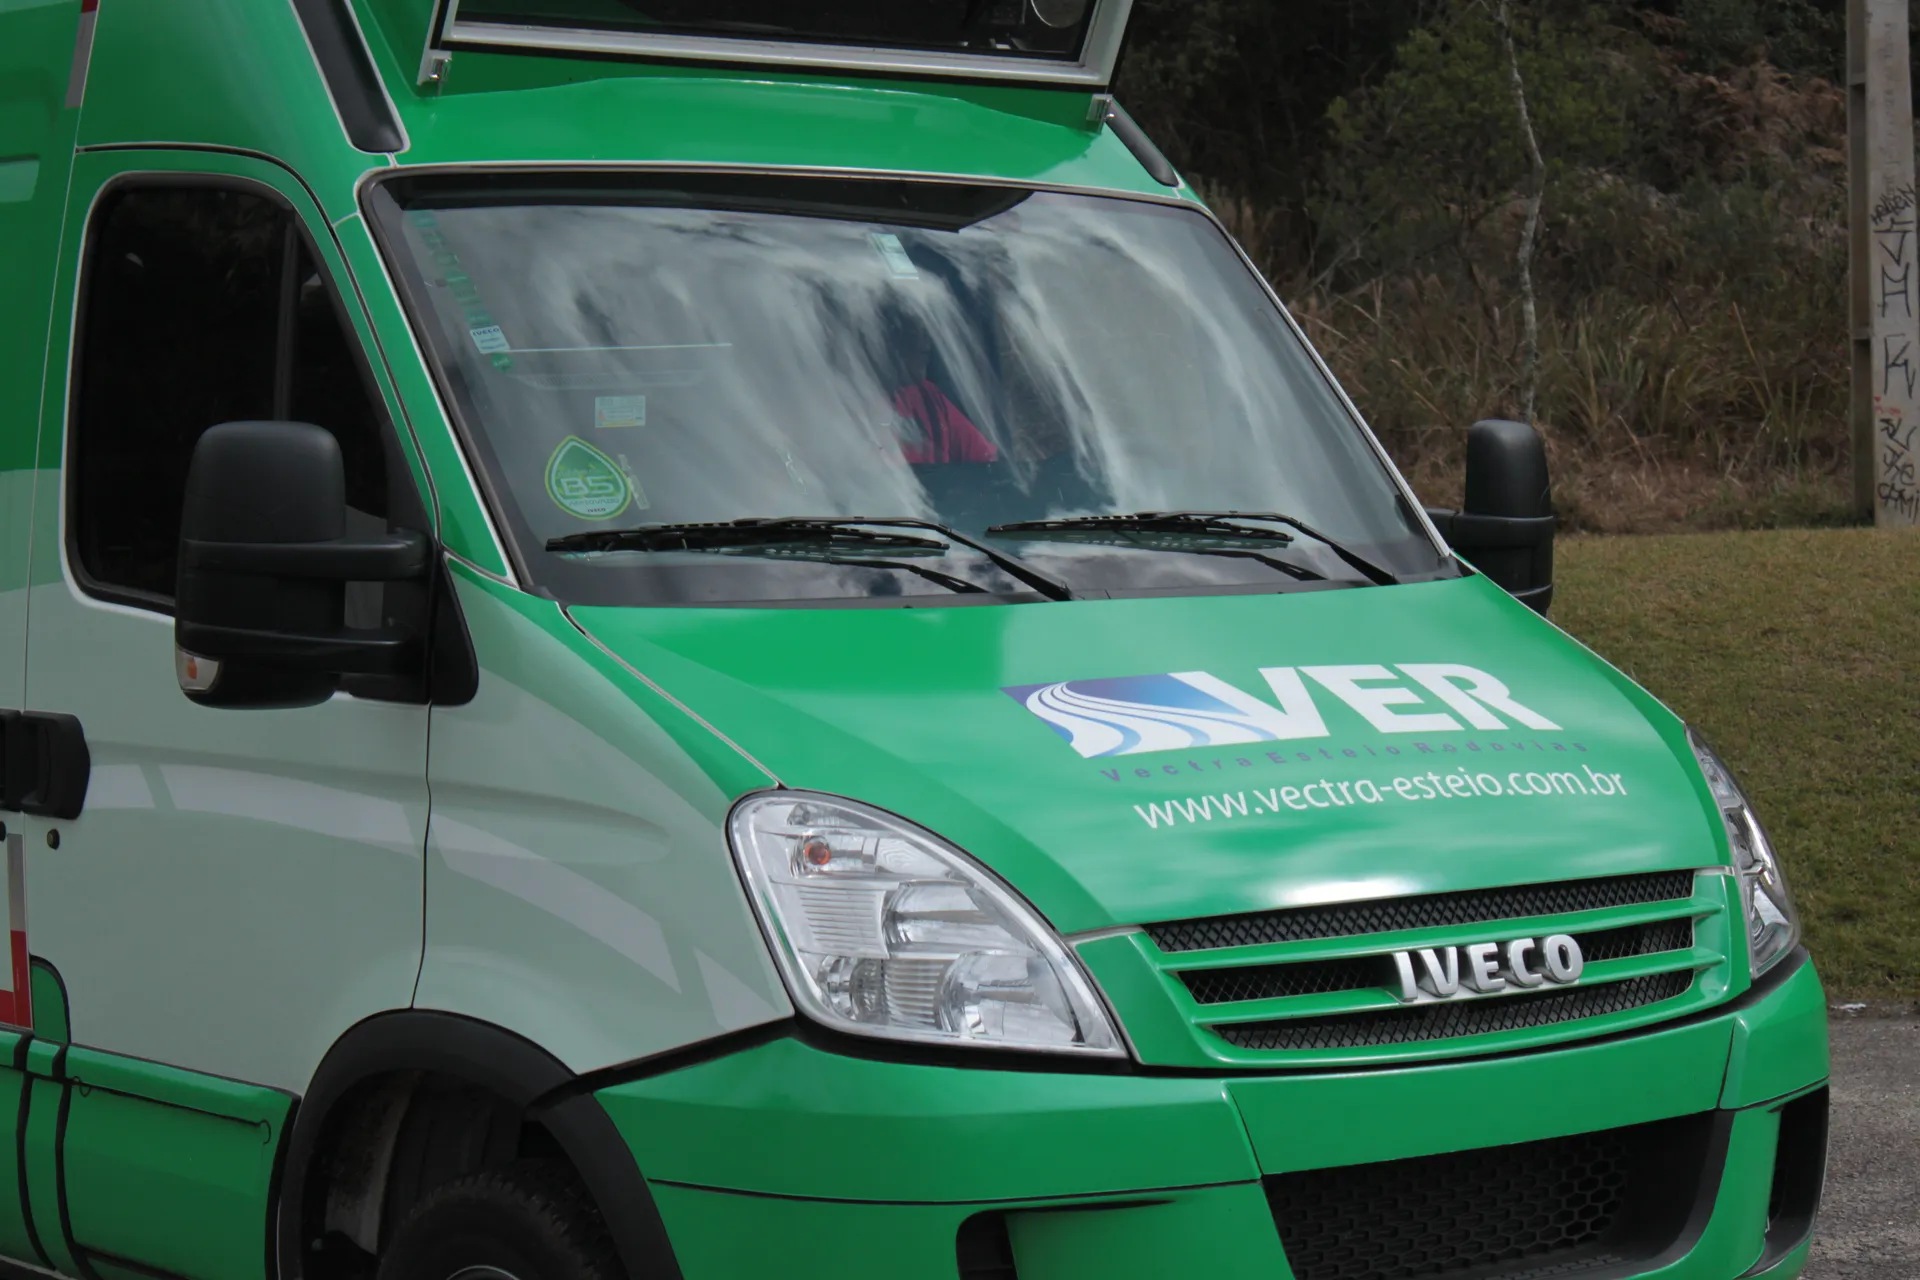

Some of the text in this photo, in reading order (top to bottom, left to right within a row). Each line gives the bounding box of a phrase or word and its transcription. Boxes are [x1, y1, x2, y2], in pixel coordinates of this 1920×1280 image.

[1165, 662, 1565, 737] VER
[1099, 739, 1589, 782] Vectra Esteio Rodovias
[1133, 763, 1628, 829] www.vectra-esteio.com.br
[1393, 934, 1584, 1002] IVECO
